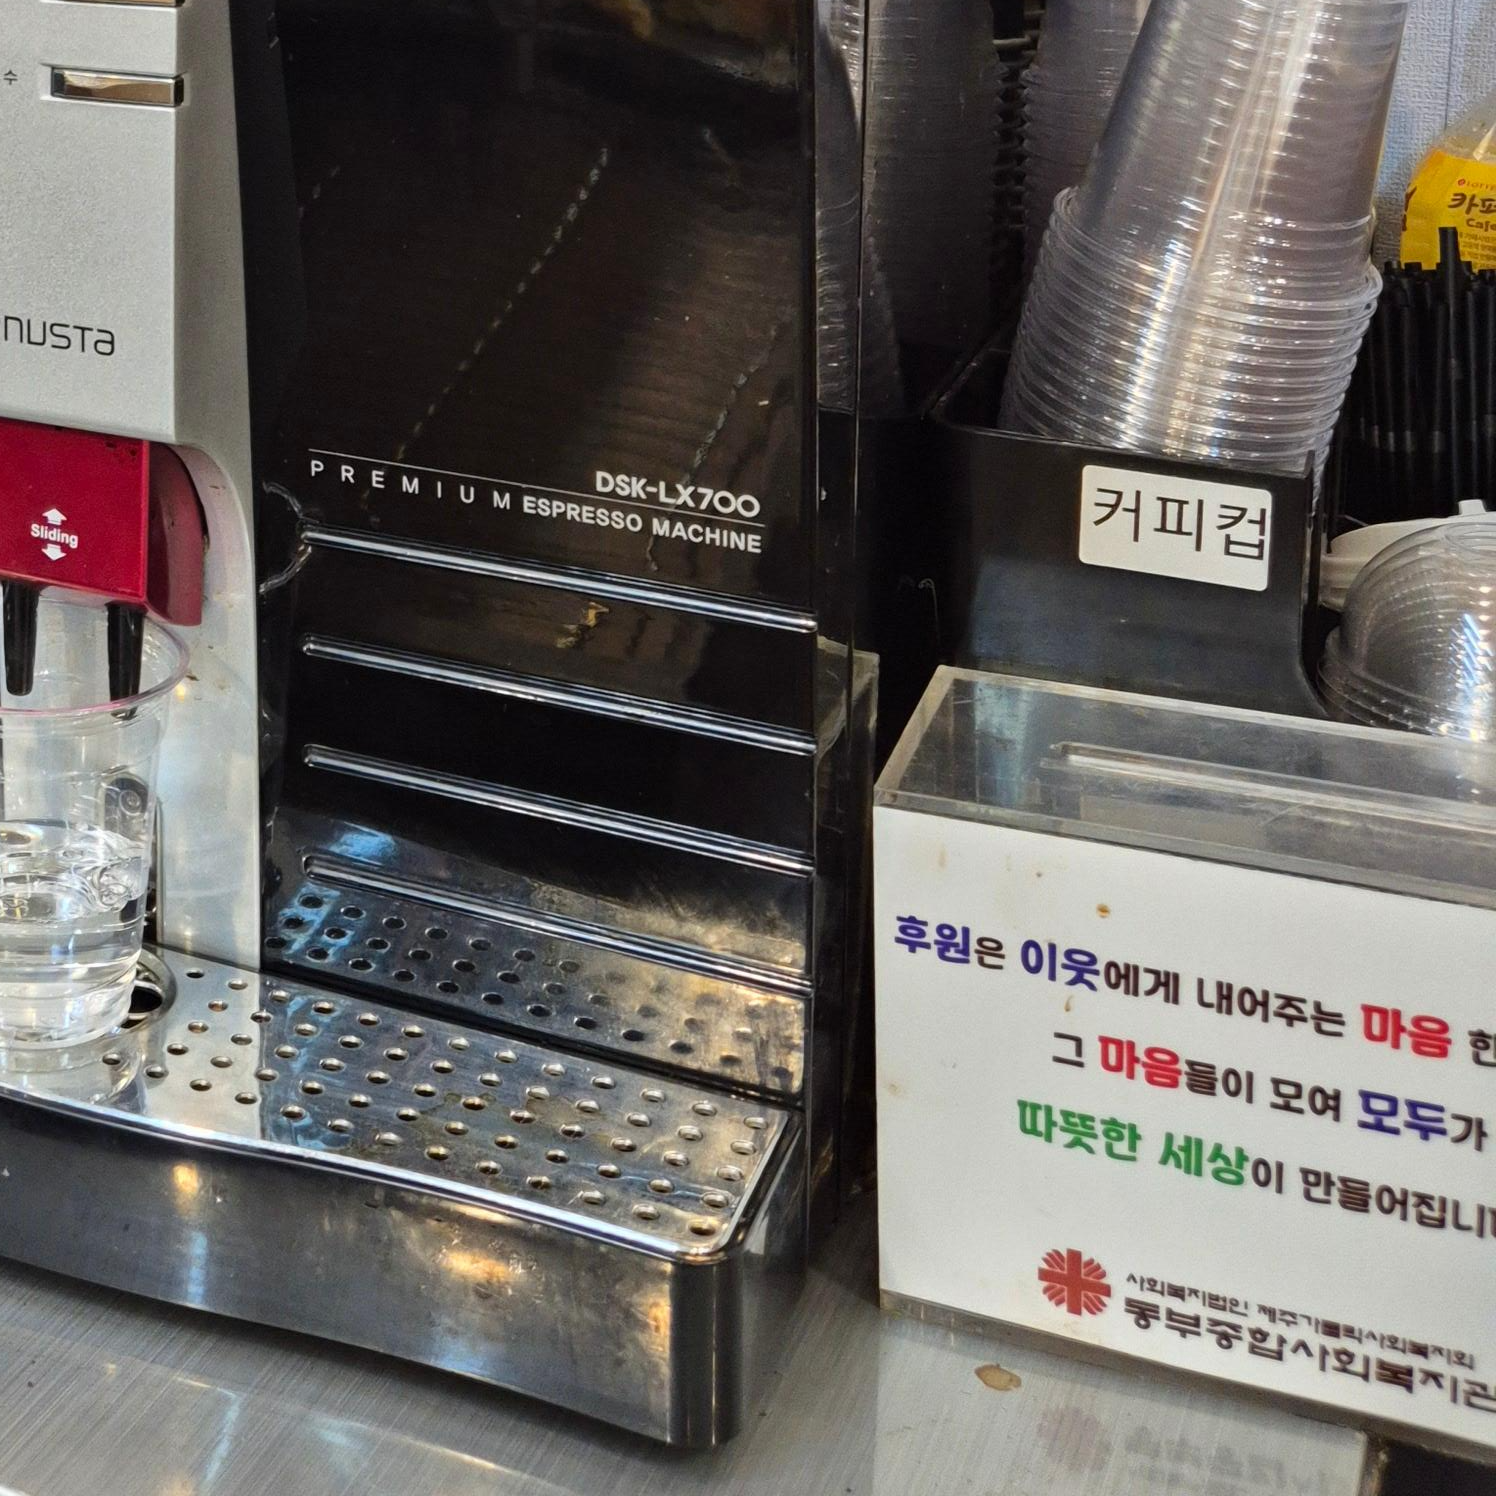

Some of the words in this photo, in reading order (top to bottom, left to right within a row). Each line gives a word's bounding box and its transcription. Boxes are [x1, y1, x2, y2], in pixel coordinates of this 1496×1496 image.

[30, 523, 79, 549] Sliding
[310, 460, 512, 510] PREMIUM
[523, 495, 643, 533] ESPRESSO
[652, 516, 762, 554] MACHINE
[595, 470, 761, 518] DSK-LX700
[1092, 486, 1266, 561] 커피컵
[895, 915, 1005, 970] 후원은
[1021, 939, 1179, 1004] 이웃에게
[1198, 978, 1345, 1037] 내어주는
[1361, 1004, 1452, 1059] 마음
[1053, 1032, 1084, 1067] 그
[1099, 1035, 1254, 1103] 마음들이
[1270, 1076, 1341, 1122] 모여
[1358, 1089, 1487, 1151] 모두가
[1017, 1099, 1142, 1161] 따뜻한
[1159, 1131, 1284, 1194] 세상이
[1127, 1272, 1248, 1316] 사회복지법인
